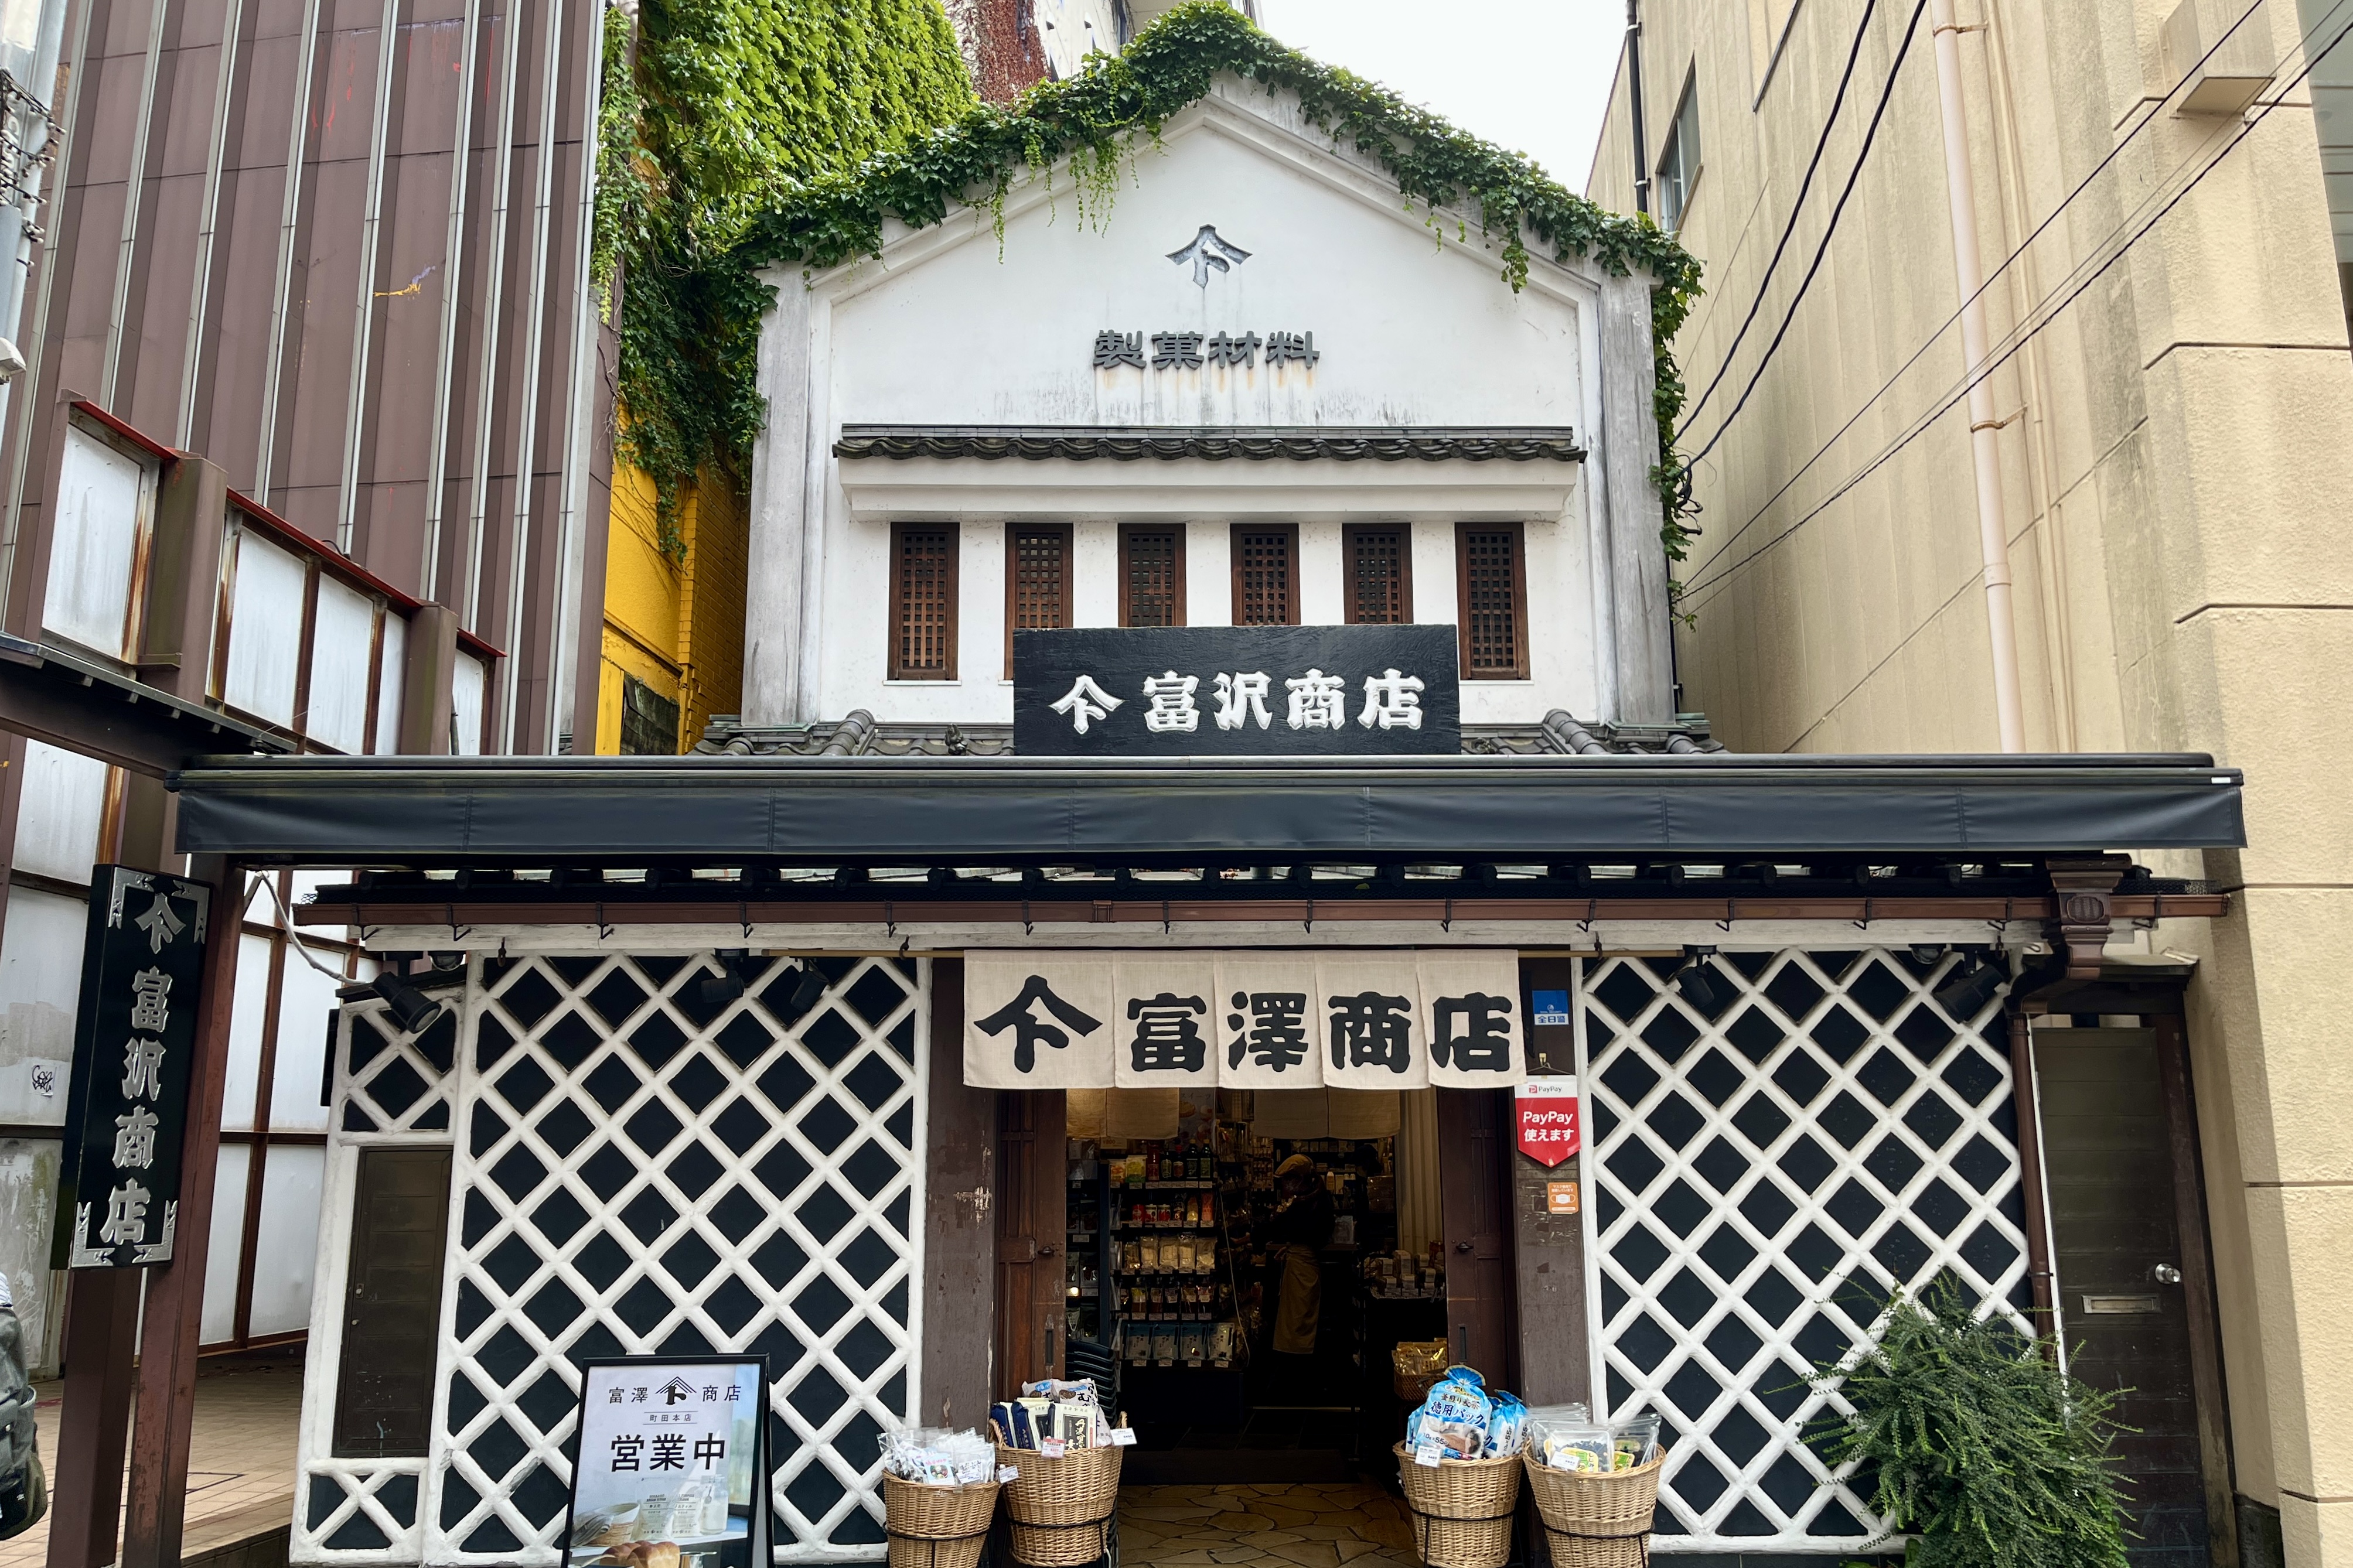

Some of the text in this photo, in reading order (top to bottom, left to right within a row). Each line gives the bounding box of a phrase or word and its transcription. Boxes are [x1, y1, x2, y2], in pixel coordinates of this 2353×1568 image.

[1093, 330, 1319, 370] 製菓材料
[1143, 668, 1426, 733] 富沢商店
[1127, 991, 1512, 1074] 富澤商店
[100, 966, 173, 1245] 富沢商店
[1523, 1111, 1573, 1125] PayPay
[1524, 1128, 1574, 1142] 使えます
[649, 1413, 692, 1422] 町田本店
[1430, 1400, 1485, 1425] 徳用パック
[611, 1433, 725, 1473] 営業中
